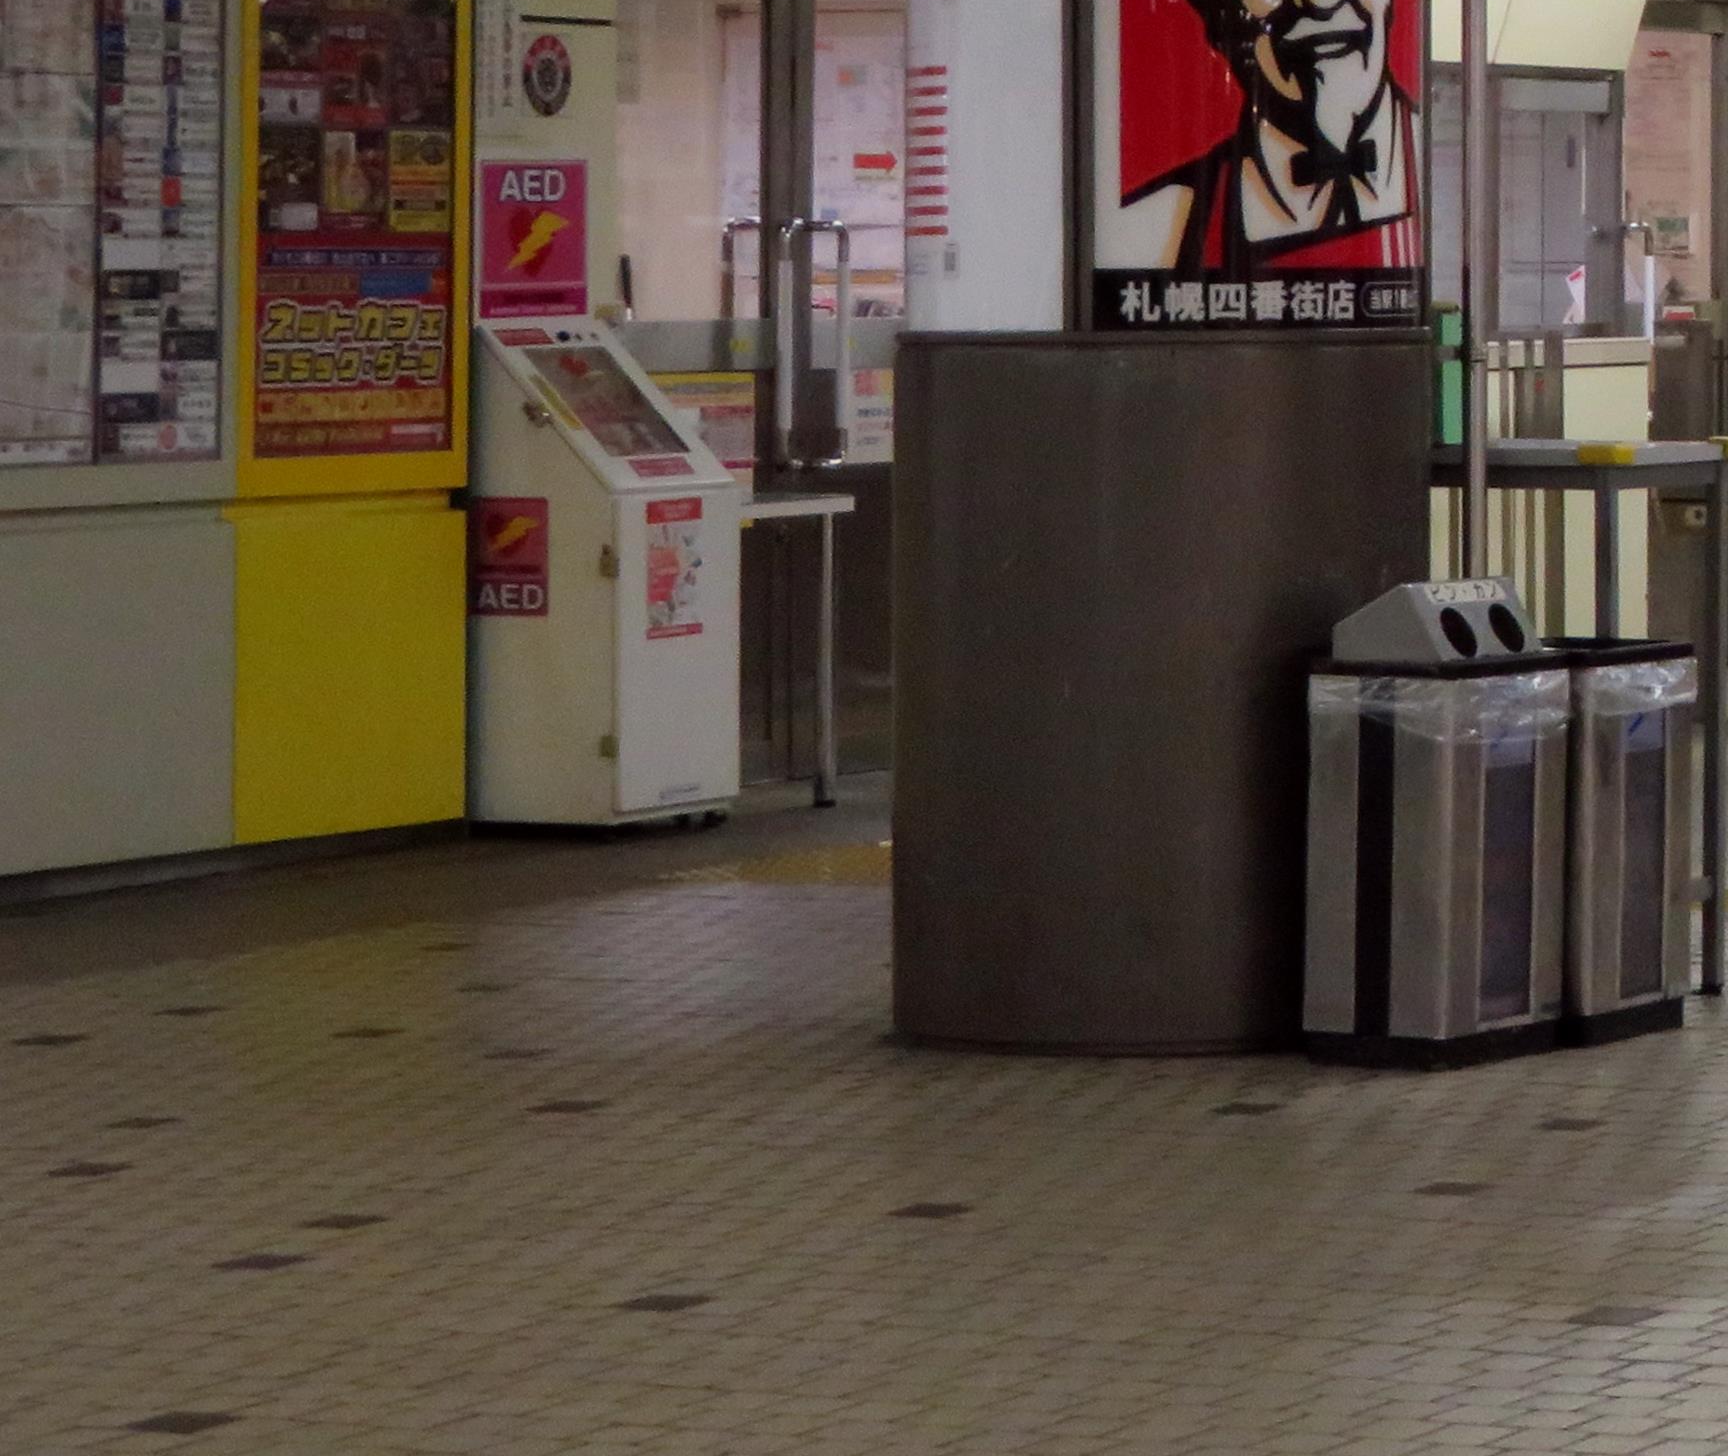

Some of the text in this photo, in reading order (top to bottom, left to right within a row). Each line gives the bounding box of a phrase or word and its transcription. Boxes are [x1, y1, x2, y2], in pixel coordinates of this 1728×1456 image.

[500, 167, 567, 202] AED
[1118, 279, 1356, 323] 札幌四番街店
[475, 583, 544, 613] AED
